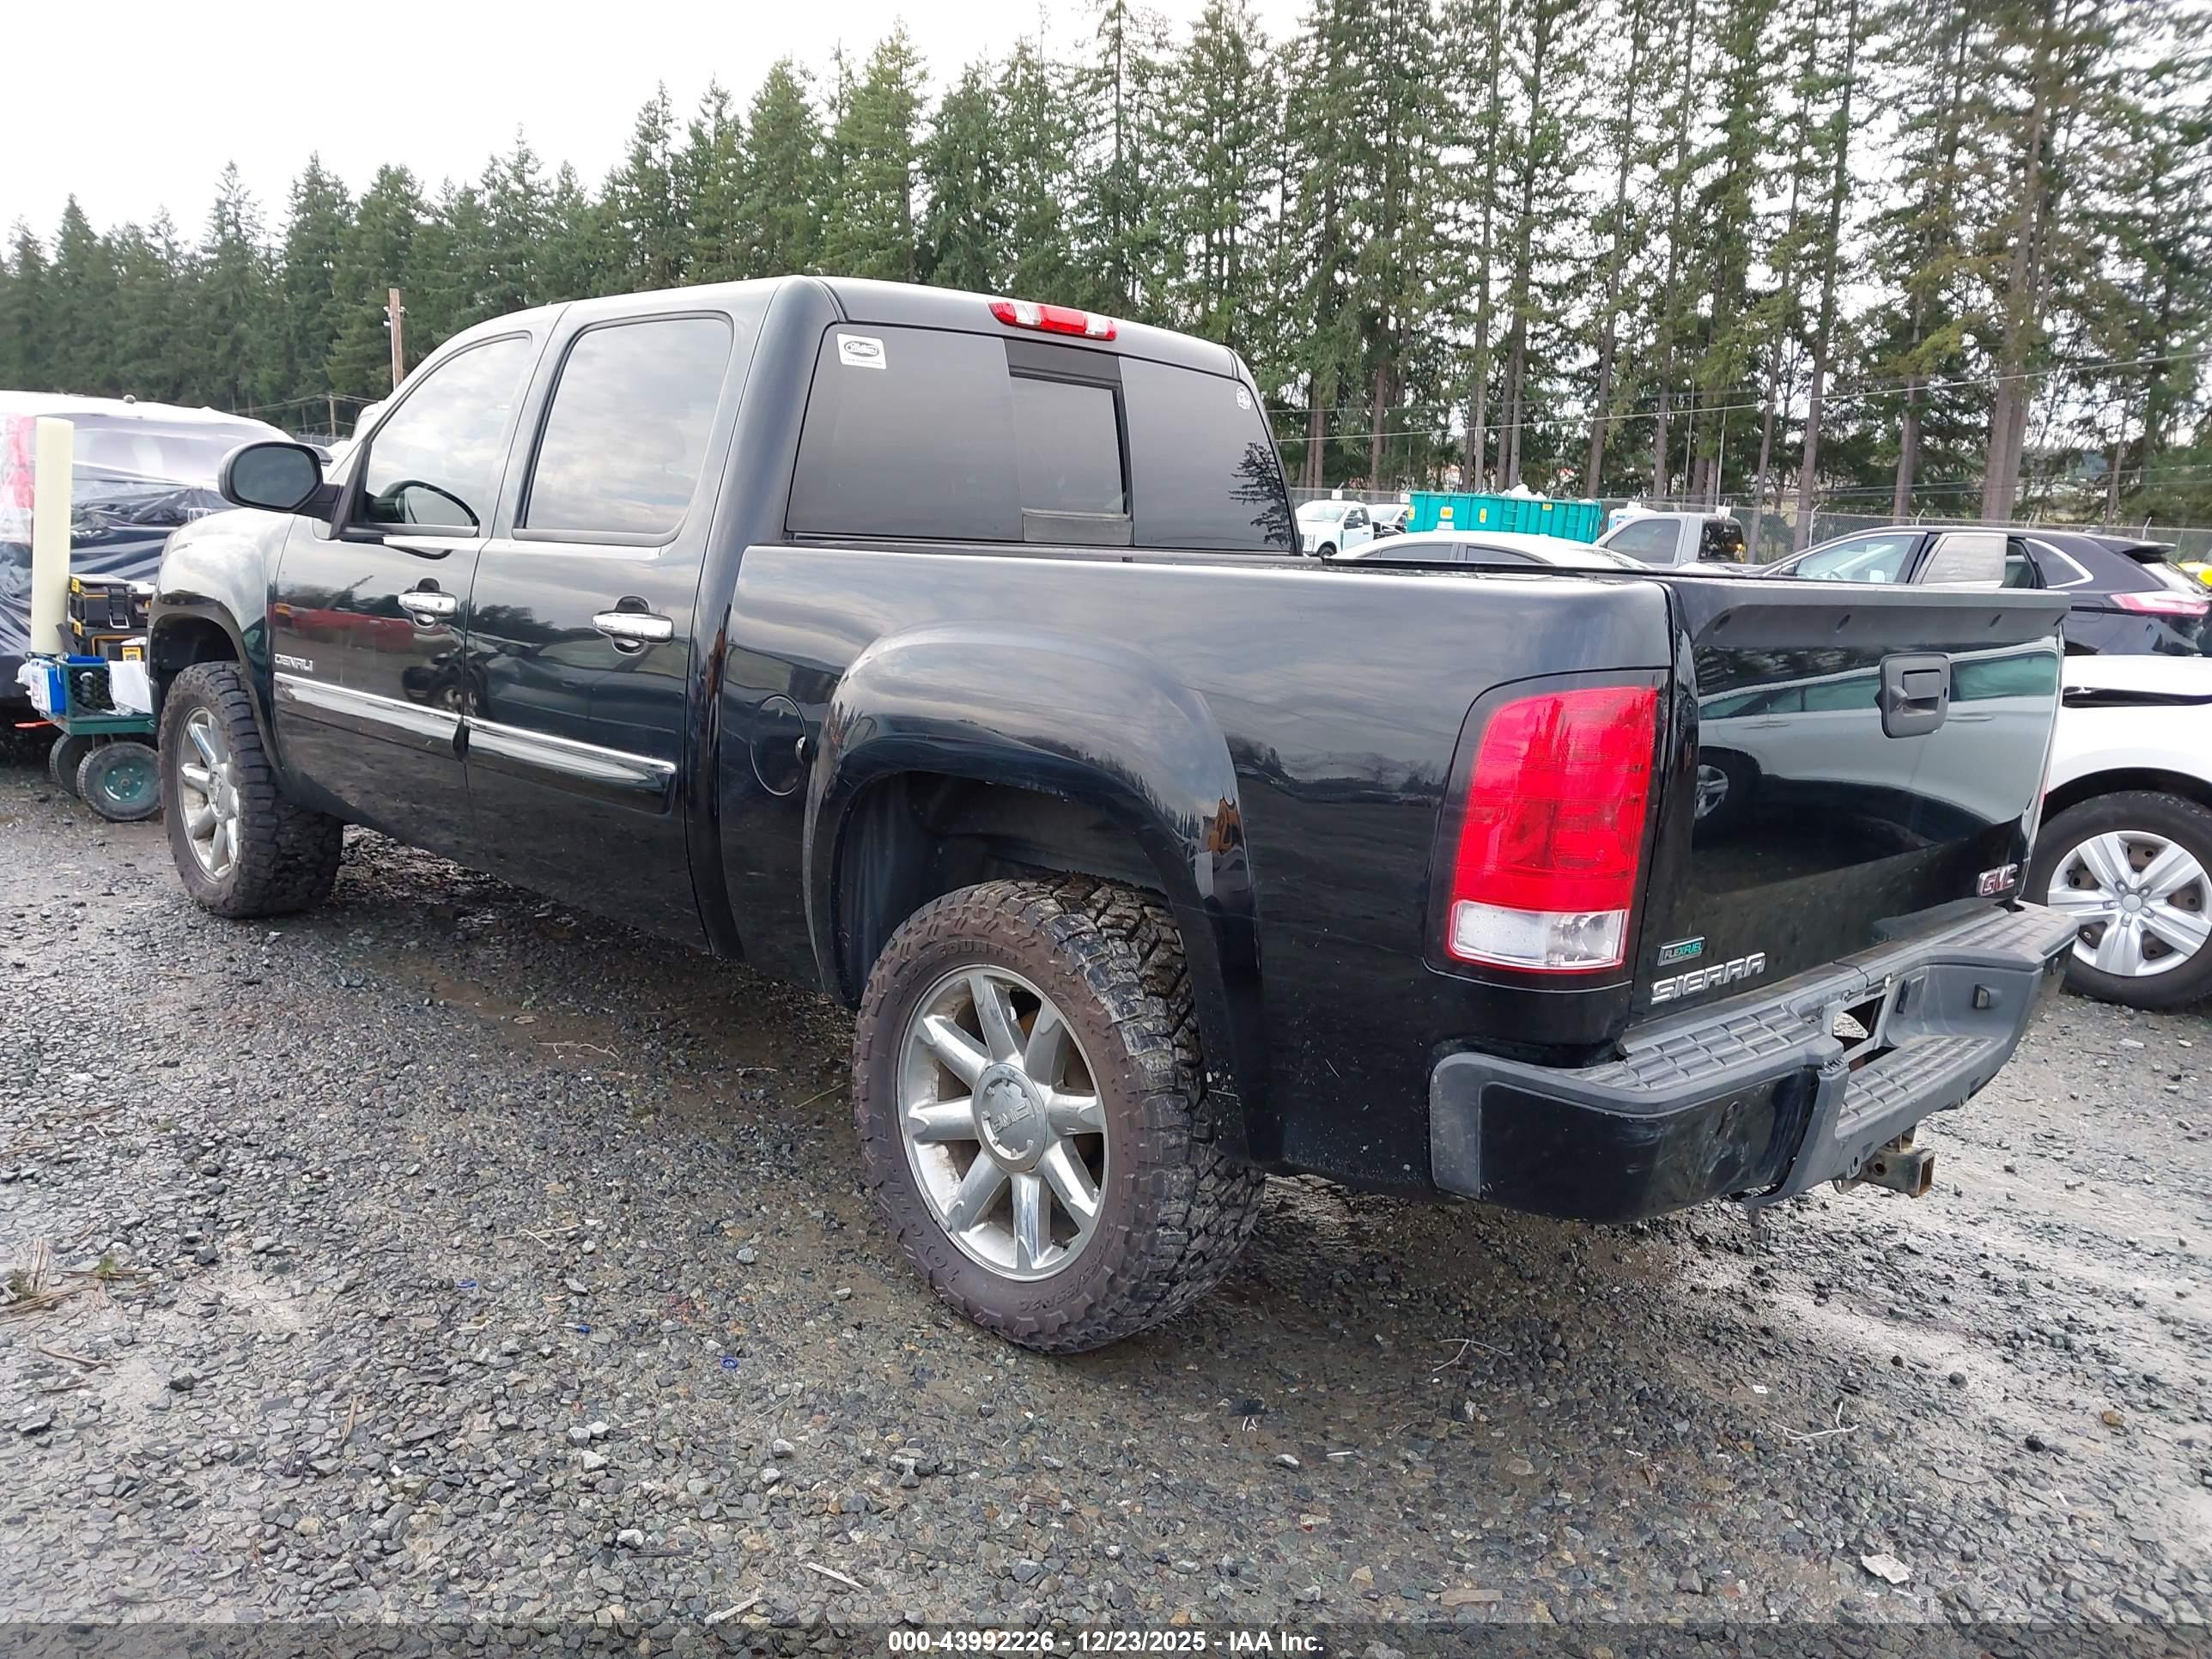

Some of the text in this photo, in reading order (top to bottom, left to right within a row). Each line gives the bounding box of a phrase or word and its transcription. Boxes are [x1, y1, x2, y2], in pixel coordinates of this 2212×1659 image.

[274, 653, 314, 672] DENALI
[1978, 863, 2018, 896] GMC
[1663, 942, 1703, 960] FLEXFUEL
[1650, 951, 1766, 1005] SIERRA
[992, 1100, 1030, 1133] GMC
